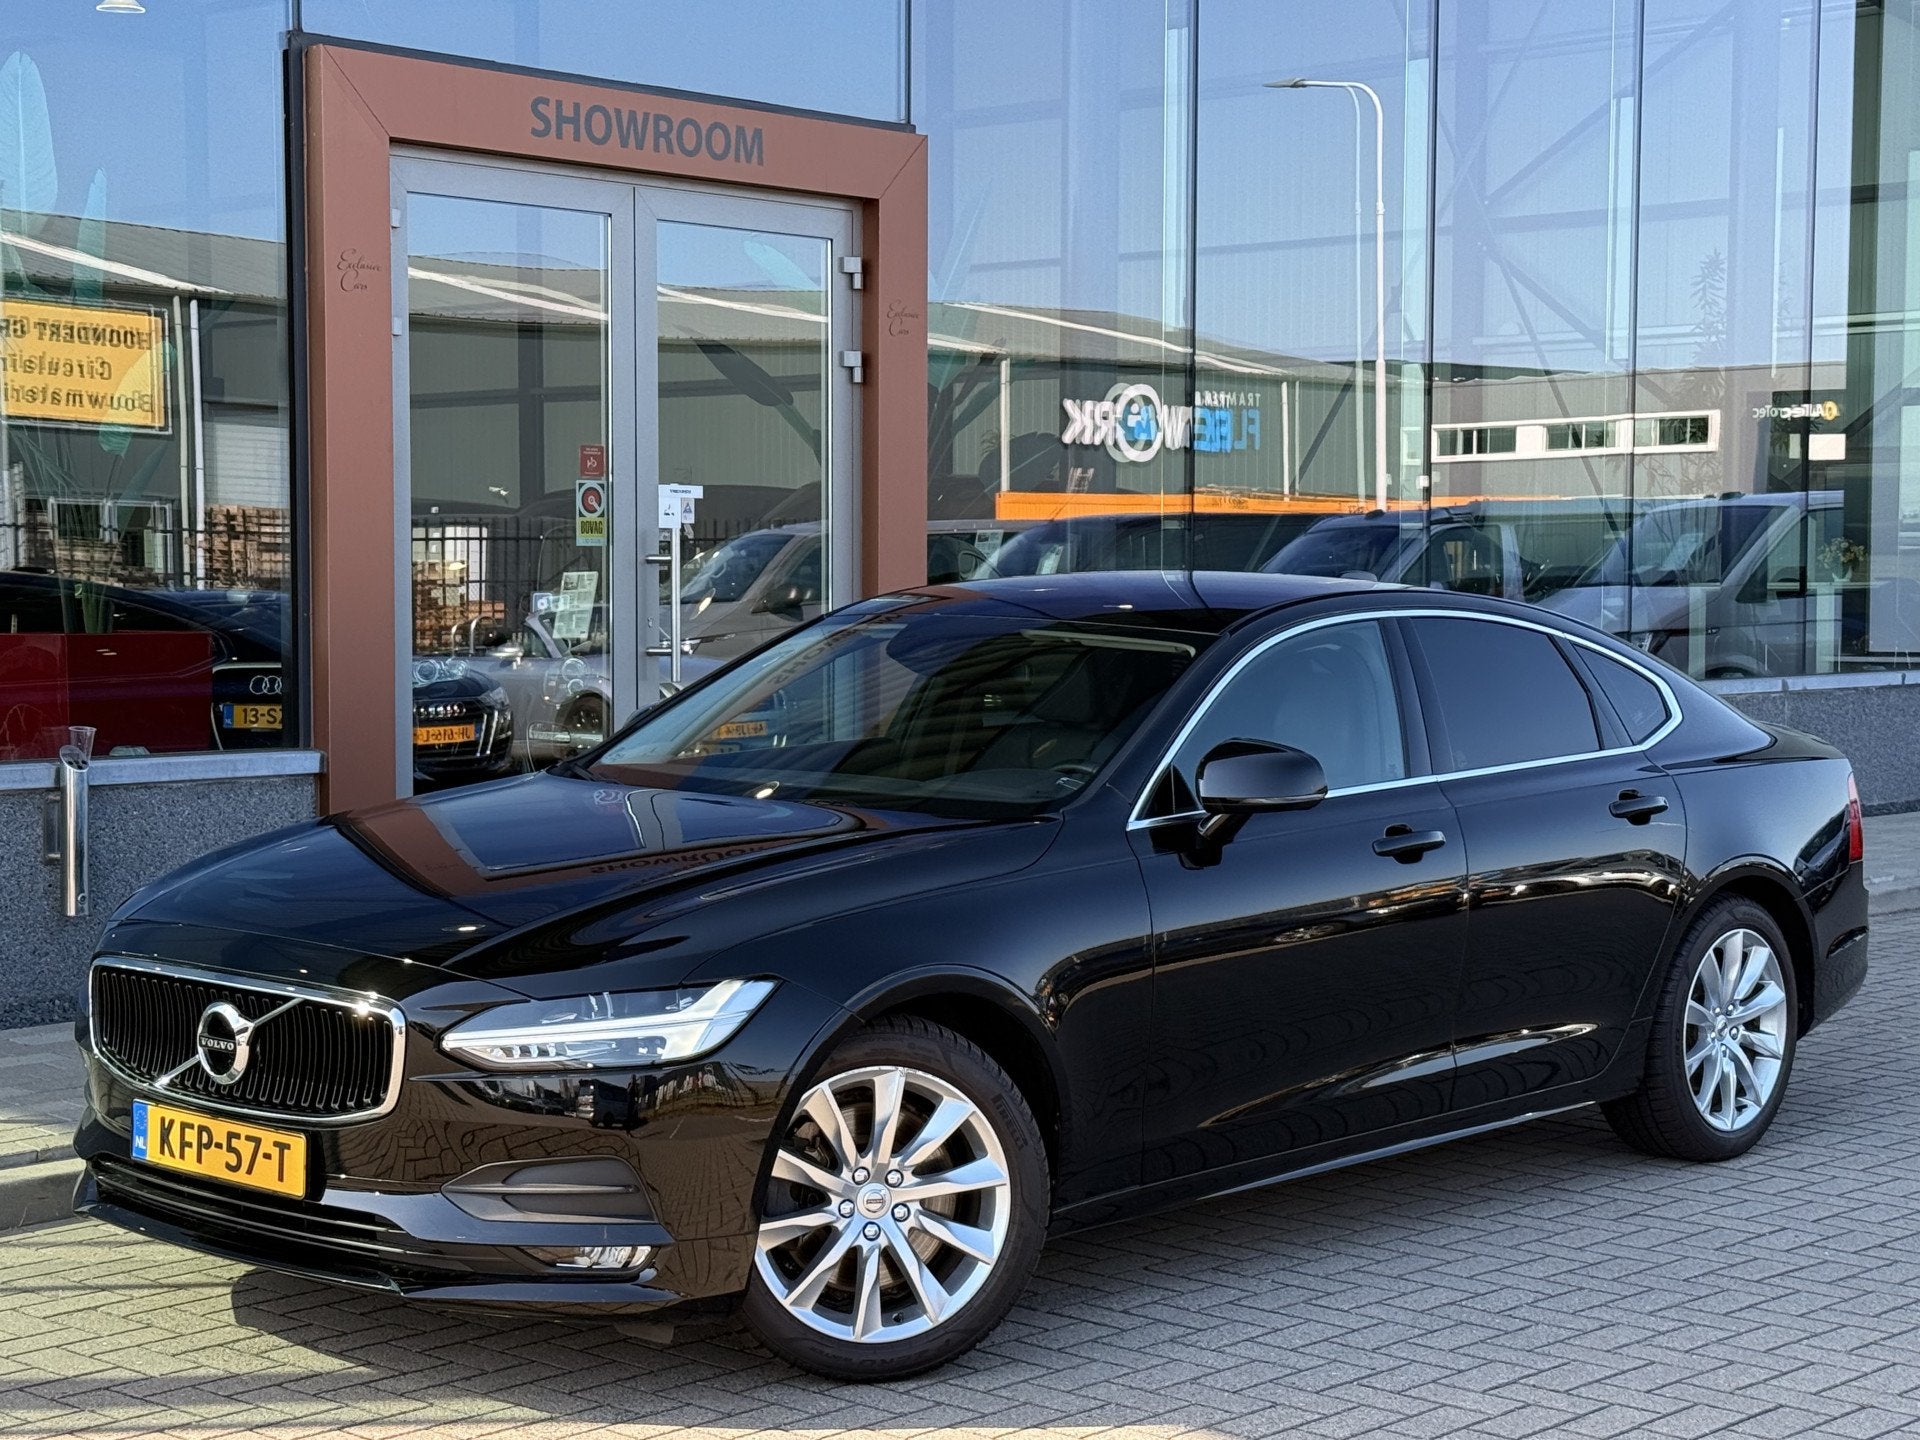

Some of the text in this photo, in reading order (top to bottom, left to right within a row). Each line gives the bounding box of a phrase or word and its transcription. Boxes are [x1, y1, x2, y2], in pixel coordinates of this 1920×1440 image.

[530, 96, 764, 166] SHOWROOM
[580, 520, 603, 535] BOVAG
[201, 1037, 235, 1051] VOLVO
[135, 1136, 147, 1150] NL
[159, 1116, 292, 1183] KFP-57-T
